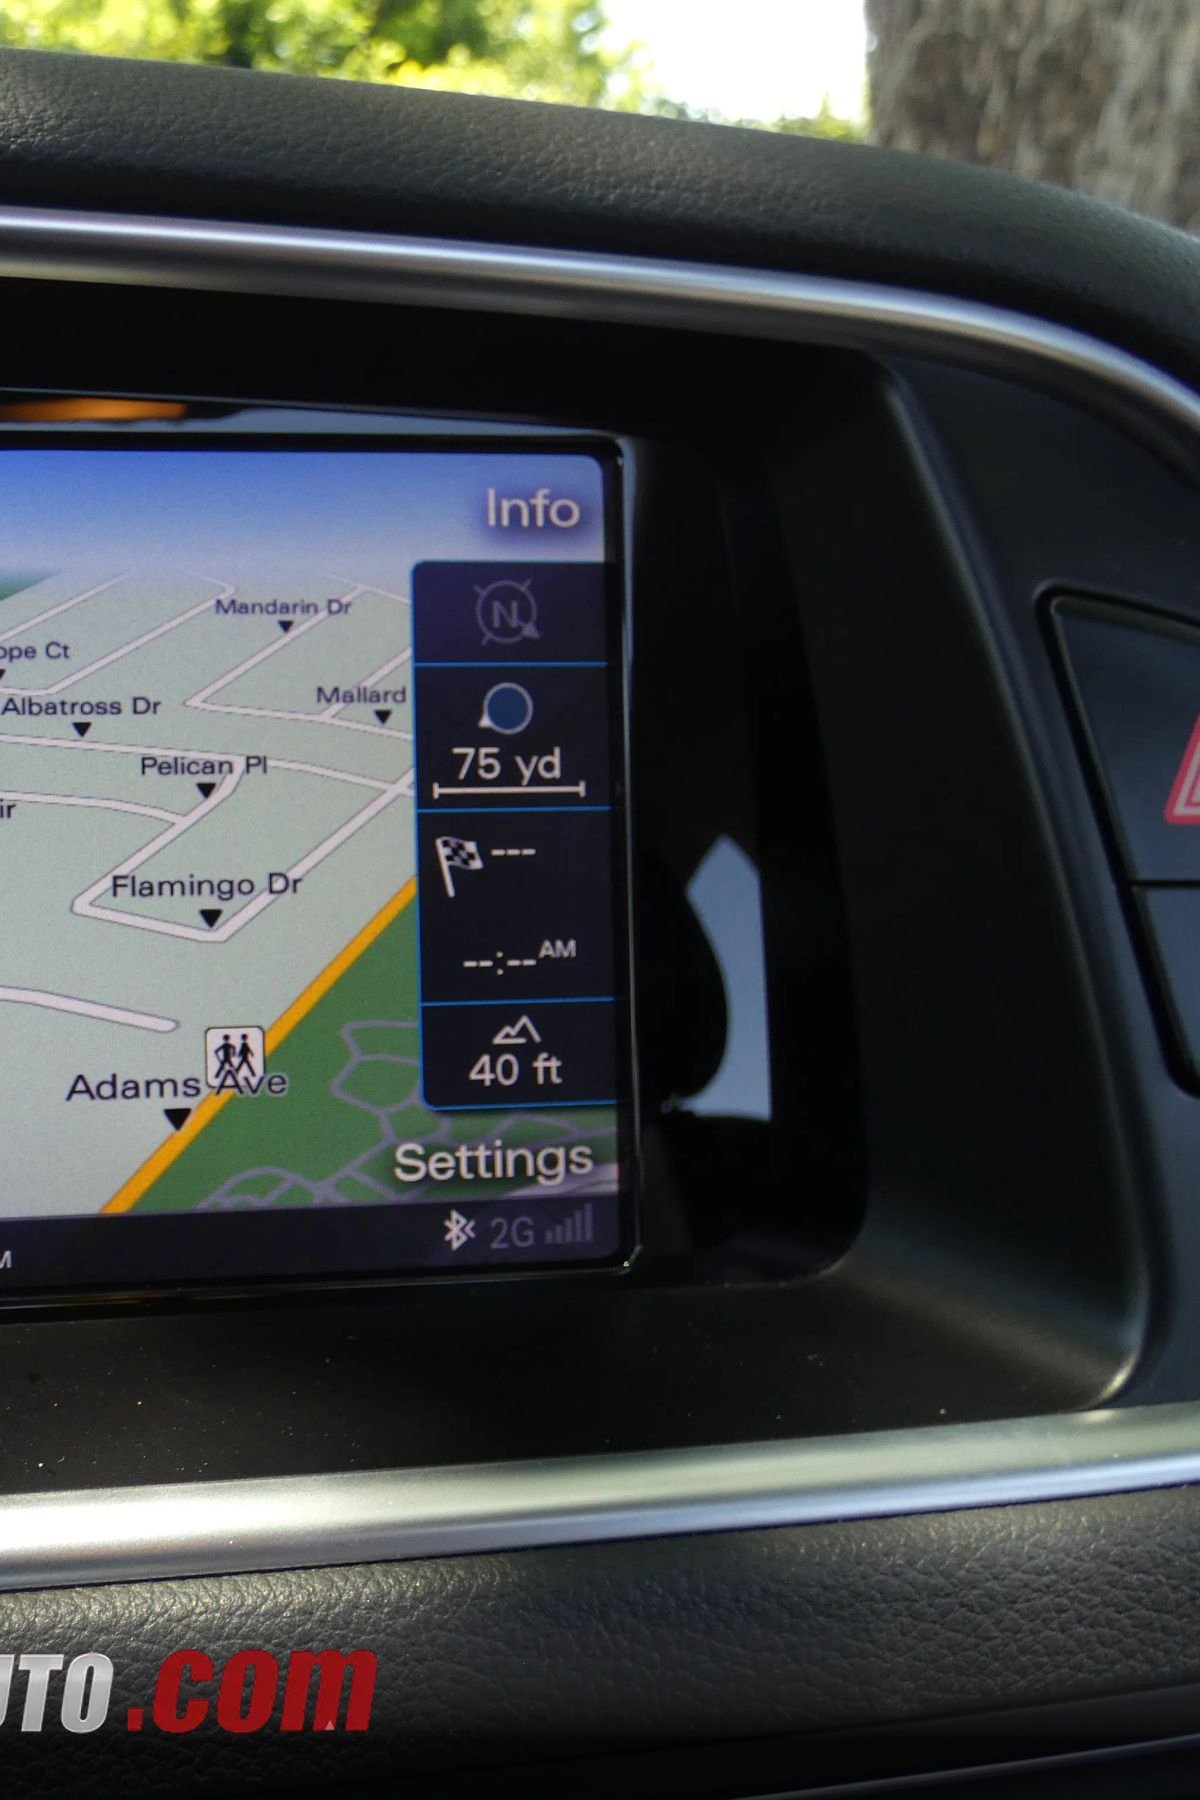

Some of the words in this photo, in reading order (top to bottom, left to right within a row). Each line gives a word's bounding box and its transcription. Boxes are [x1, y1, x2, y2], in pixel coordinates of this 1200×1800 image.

[486, 488, 581, 528] Info
[214, 598, 319, 616] Mandarin
[327, 598, 353, 616] Dr
[45, 642, 70, 661] Ct
[0, 697, 123, 718] Albatross
[131, 697, 162, 716] Dr
[316, 686, 407, 705] Mallard
[139, 756, 235, 777] Pelican
[244, 755, 268, 776] Pl
[451, 747, 502, 781] 75
[514, 746, 562, 786] yd
[110, 874, 256, 902] Flamingo
[268, 873, 304, 898] Dr
[468, 1054, 520, 1088] 40
[532, 1052, 563, 1086] ft
[66, 1073, 202, 1102] Adams
[216, 1070, 289, 1097] Ave
[394, 1139, 594, 1187] Settings
[490, 1216, 536, 1249] 2G
